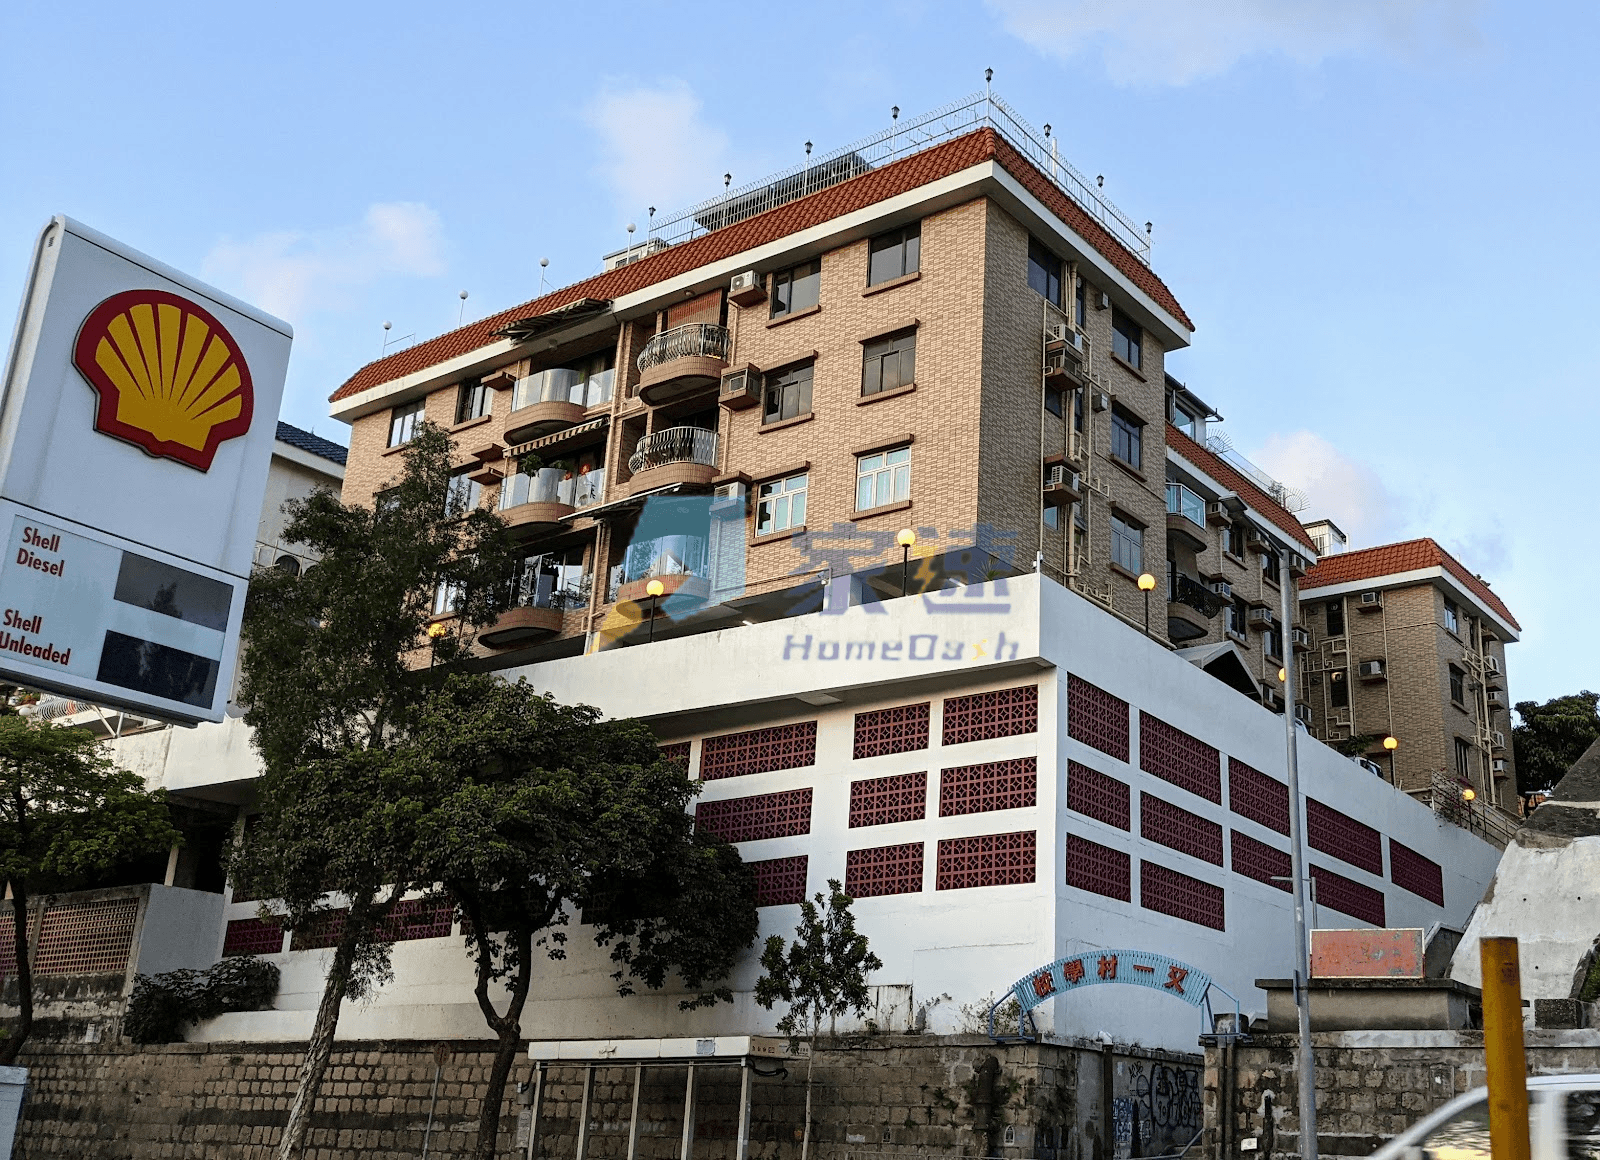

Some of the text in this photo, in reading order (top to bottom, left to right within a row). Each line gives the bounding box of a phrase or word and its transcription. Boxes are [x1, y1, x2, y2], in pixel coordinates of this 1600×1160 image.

[22, 526, 61, 553] Shell
[16, 547, 65, 577] Diesel
[3, 608, 42, 635] Shell
[0, 630, 71, 666] Unleaded
